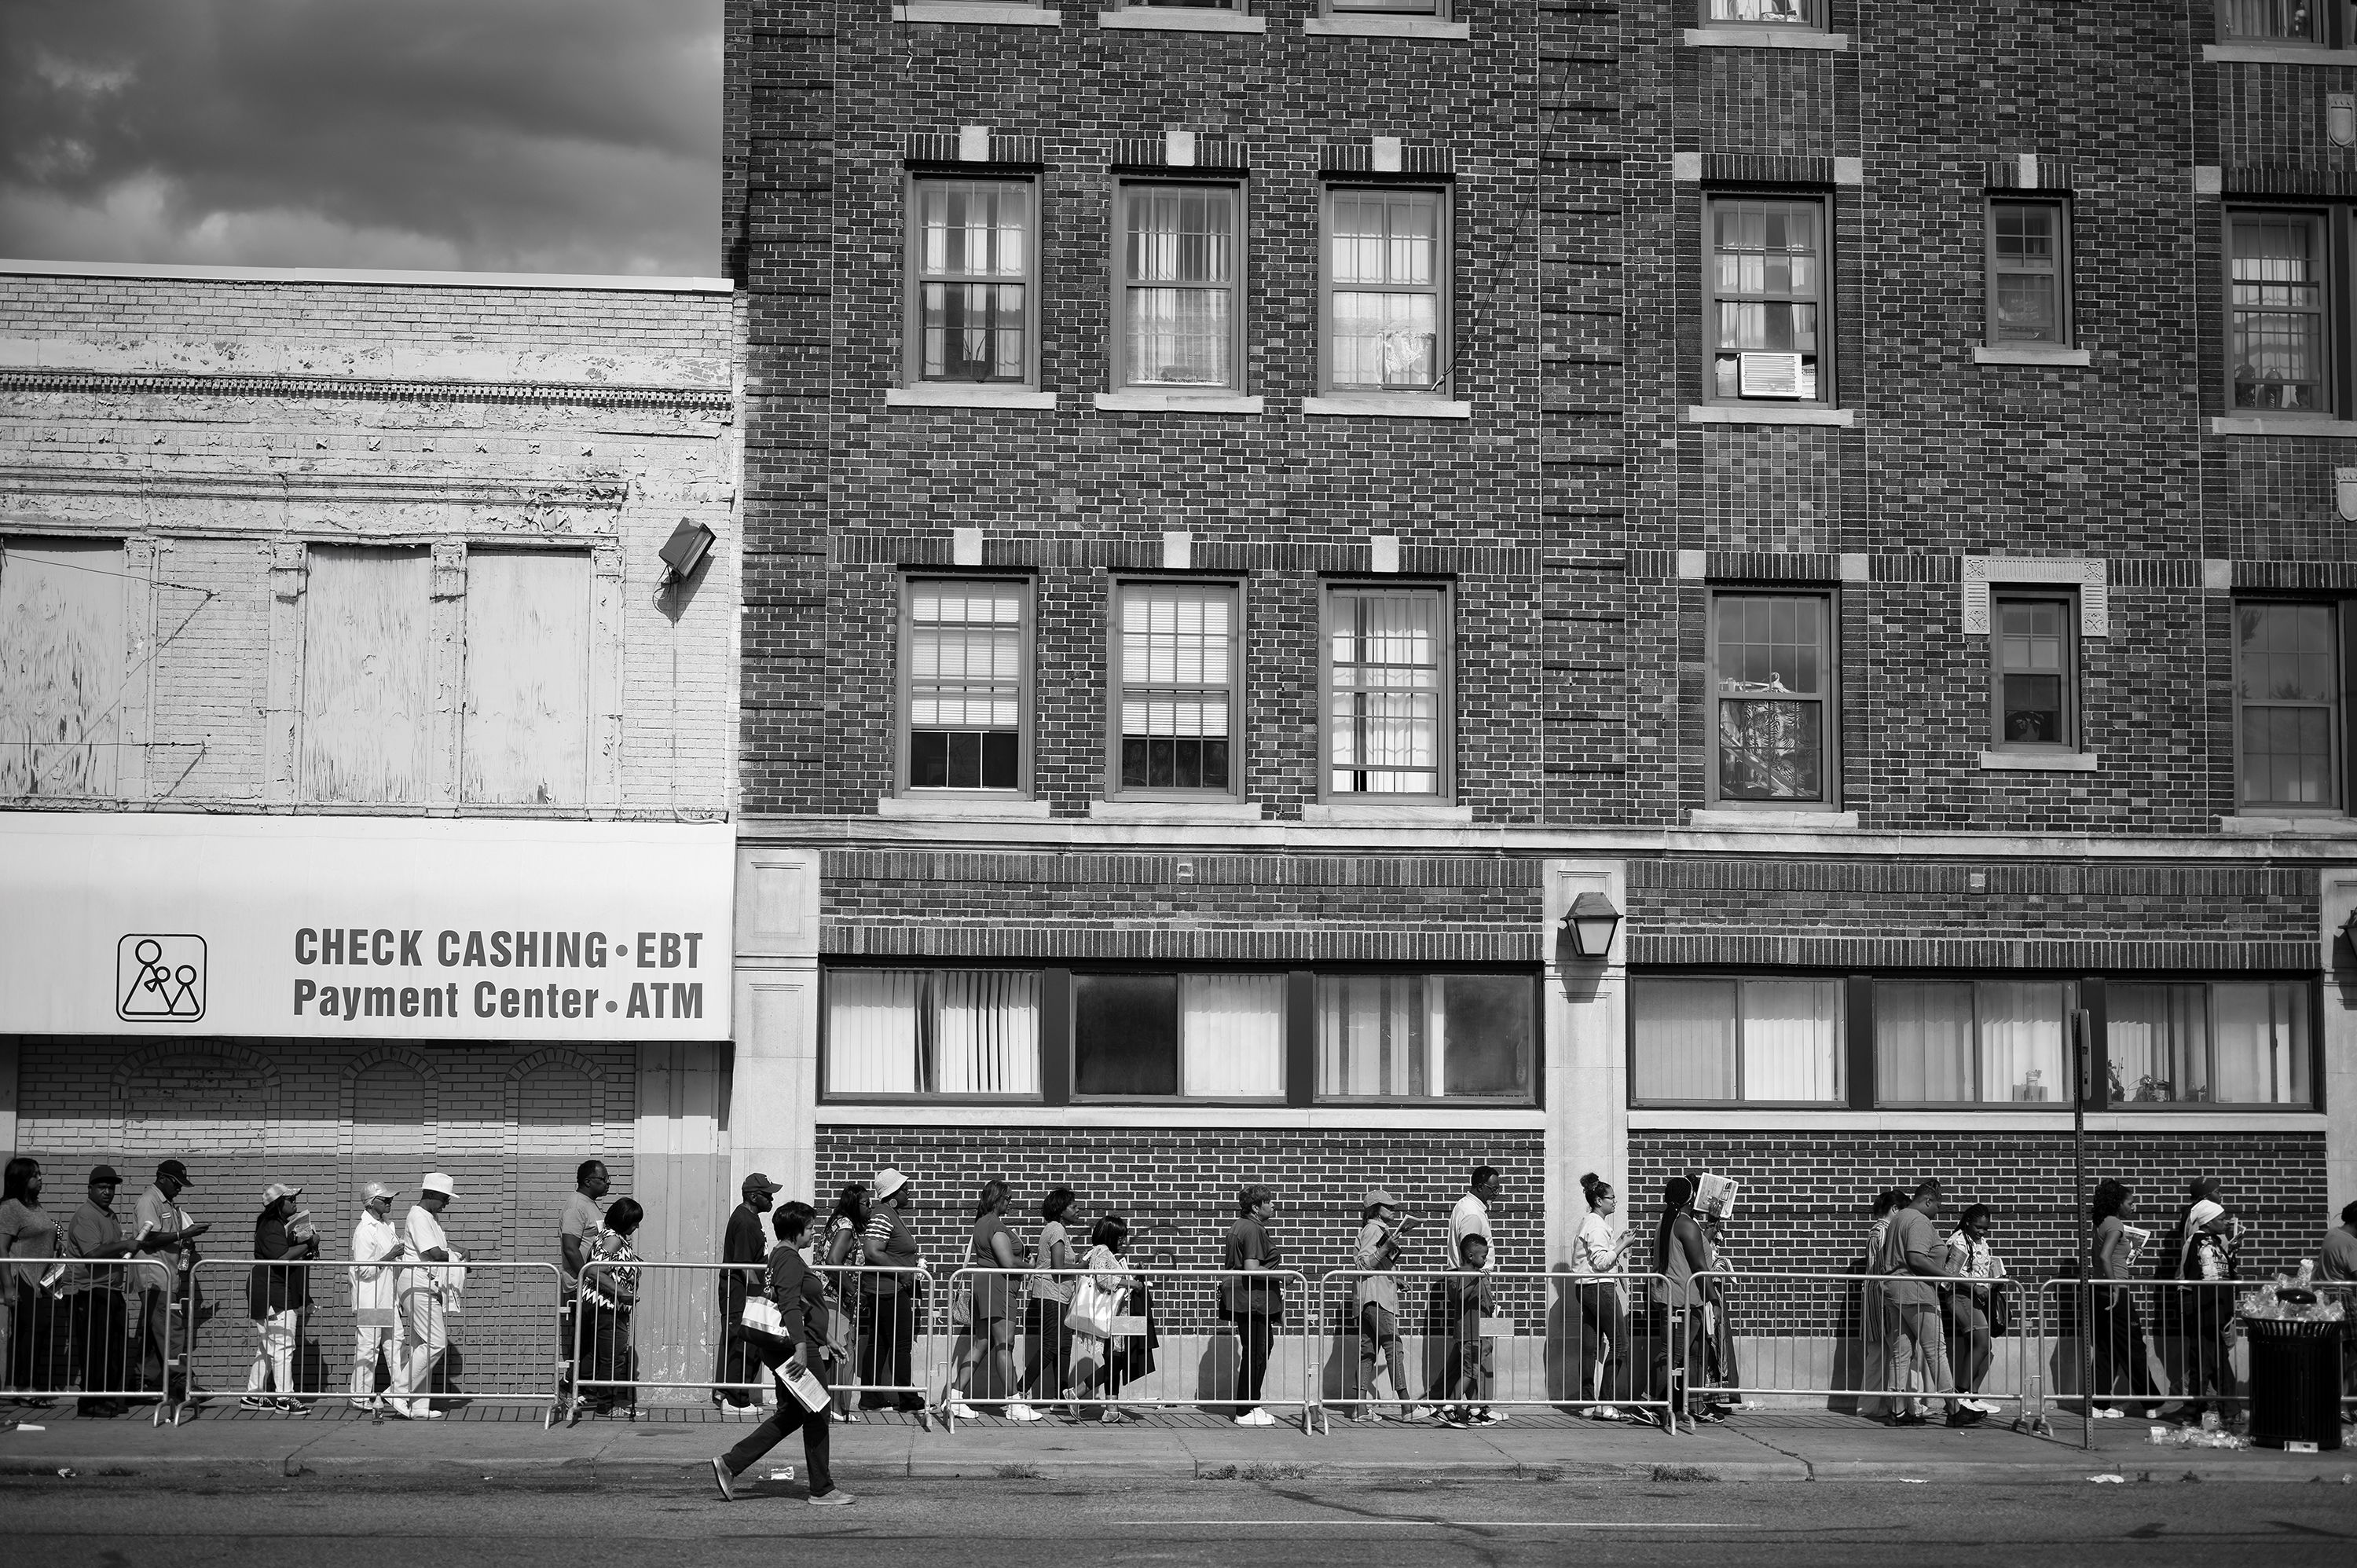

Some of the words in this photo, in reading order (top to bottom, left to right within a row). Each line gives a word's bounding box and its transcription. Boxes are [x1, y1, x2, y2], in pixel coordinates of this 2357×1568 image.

[295, 928, 423, 967] CHECK
[438, 930, 607, 969] CASHING
[636, 932, 703, 969] EBT
[294, 979, 458, 1020] Payment
[474, 980, 599, 1019] Center
[625, 982, 703, 1019] ATM
